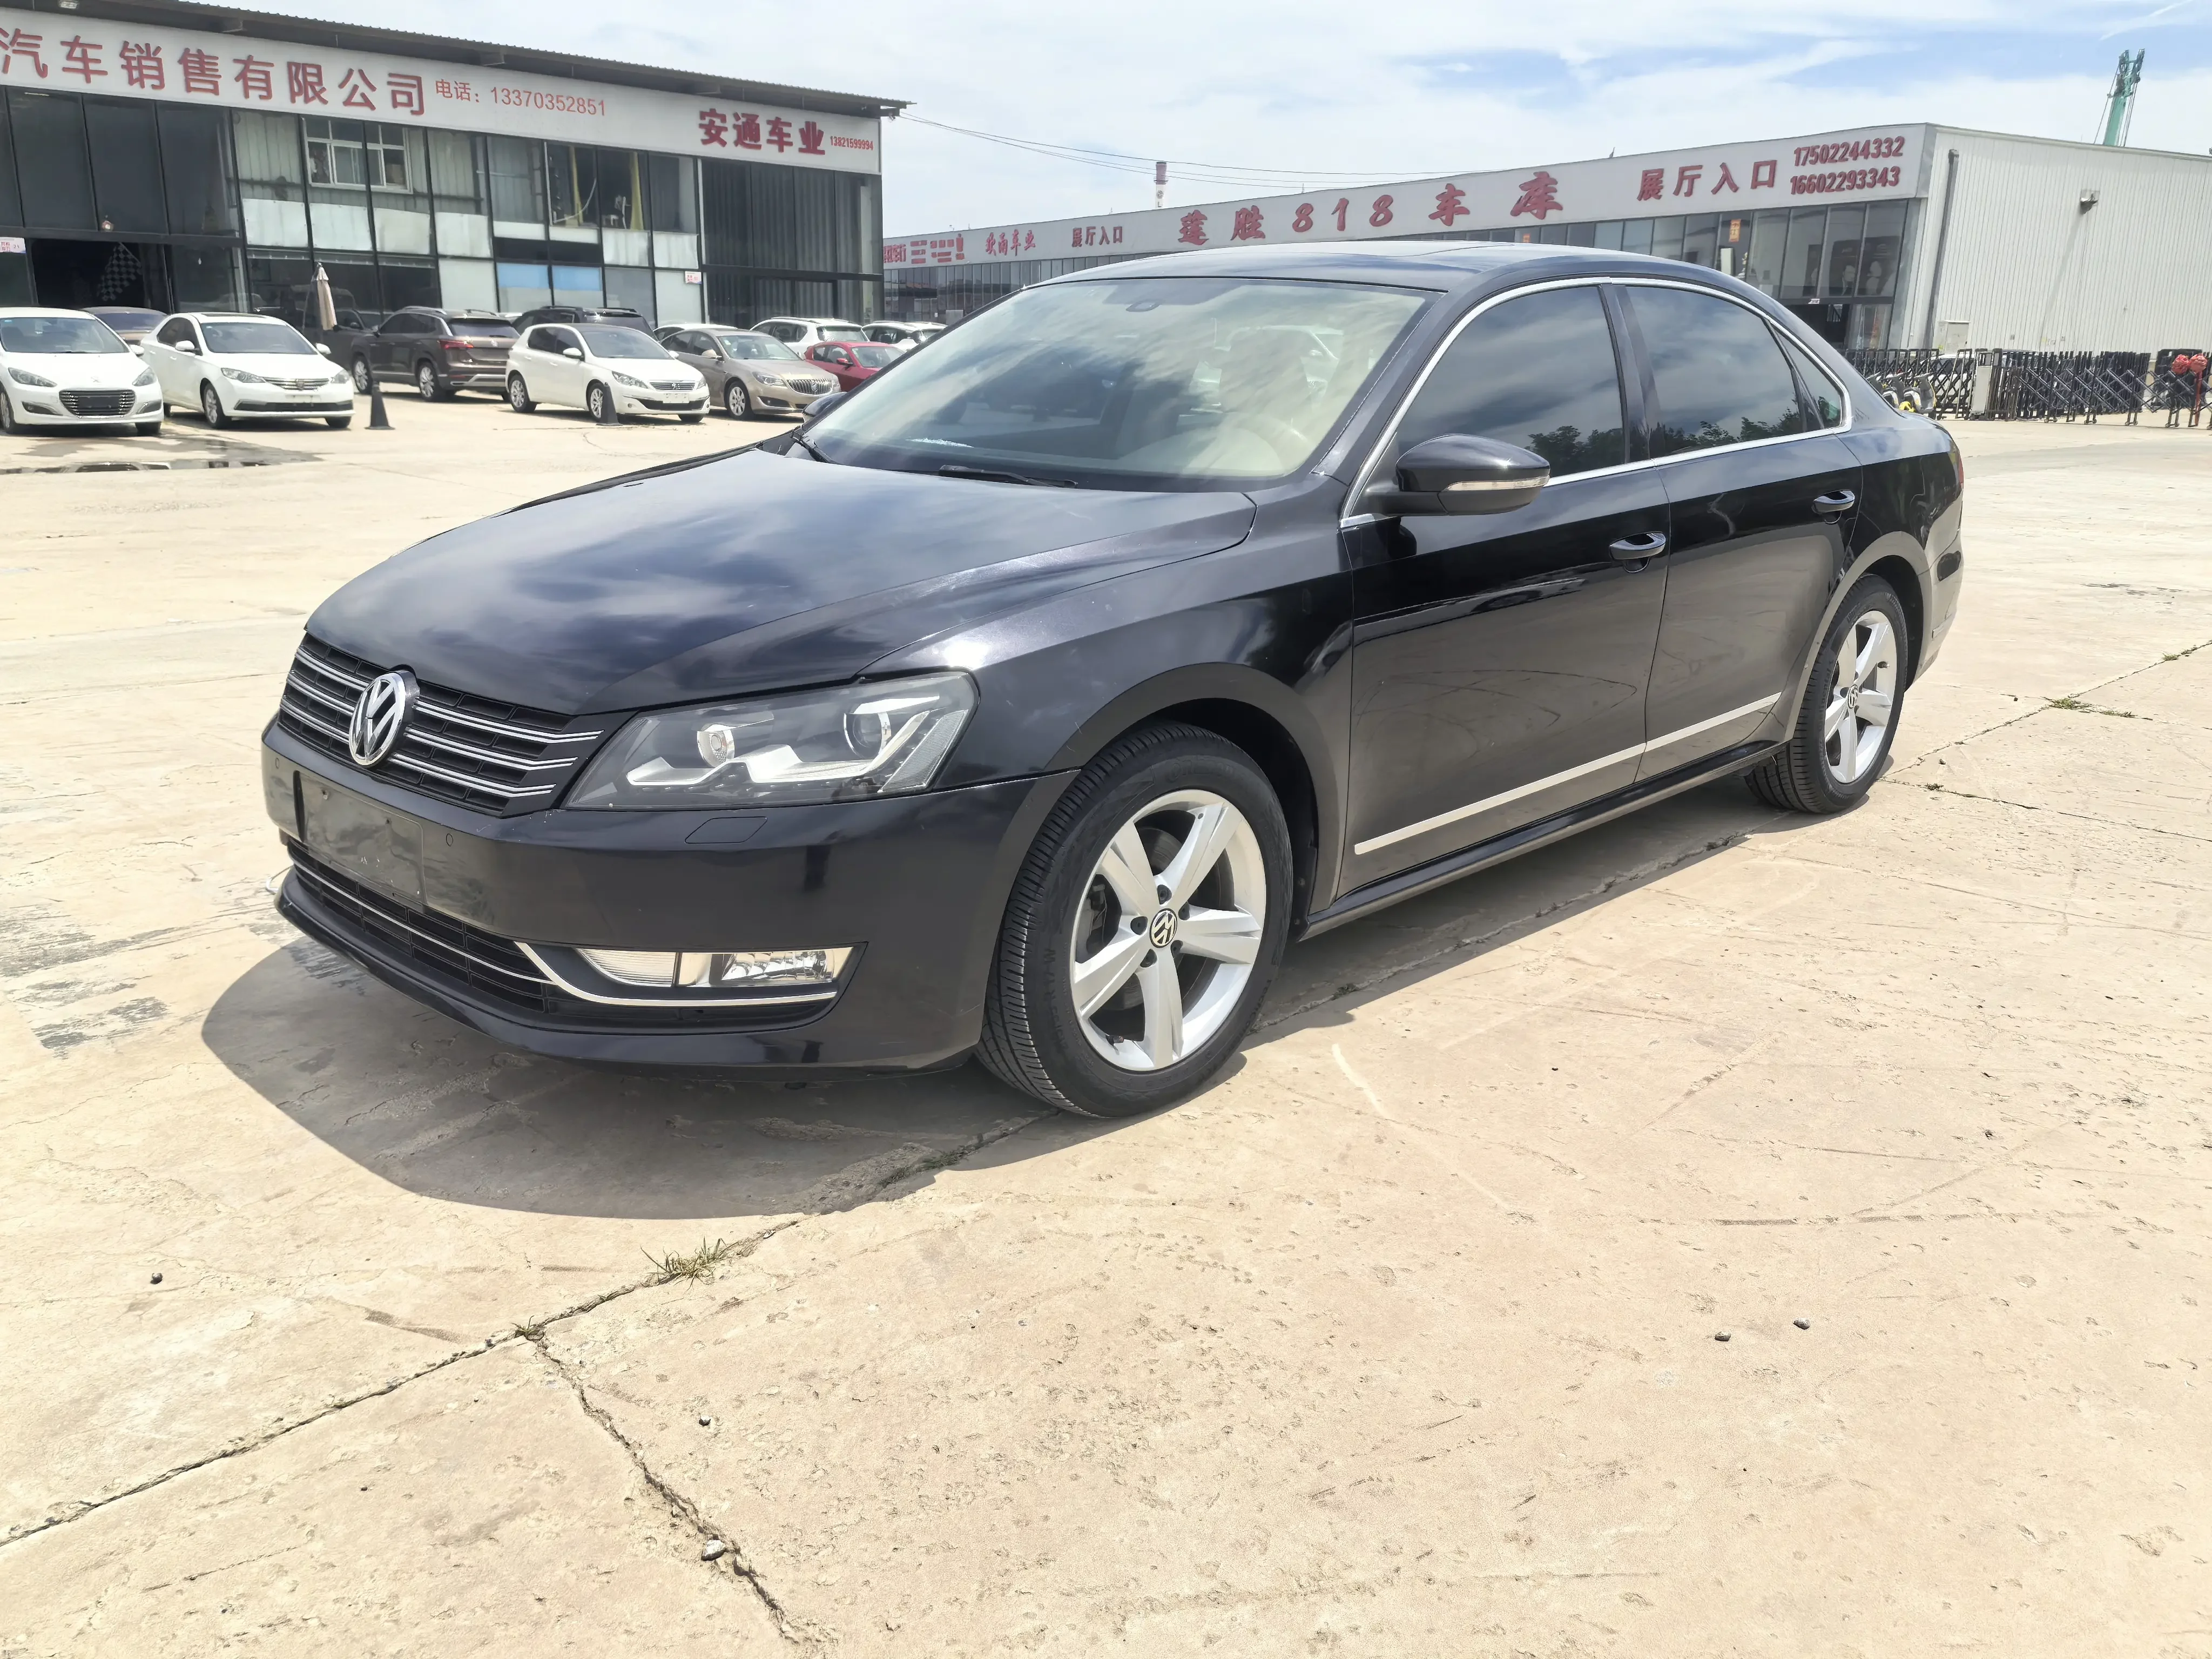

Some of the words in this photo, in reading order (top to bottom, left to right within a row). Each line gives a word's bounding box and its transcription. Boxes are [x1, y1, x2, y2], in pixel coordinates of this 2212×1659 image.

[0, 28, 425, 116] 汽车销售有限公司
[698, 108, 826, 155] 安通车业
[1793, 136, 1905, 167] 17502244332
[1637, 159, 1777, 202] 展厅入口
[1790, 165, 1901, 195] 16602293343
[1071, 226, 1123, 248] 展厅入口
